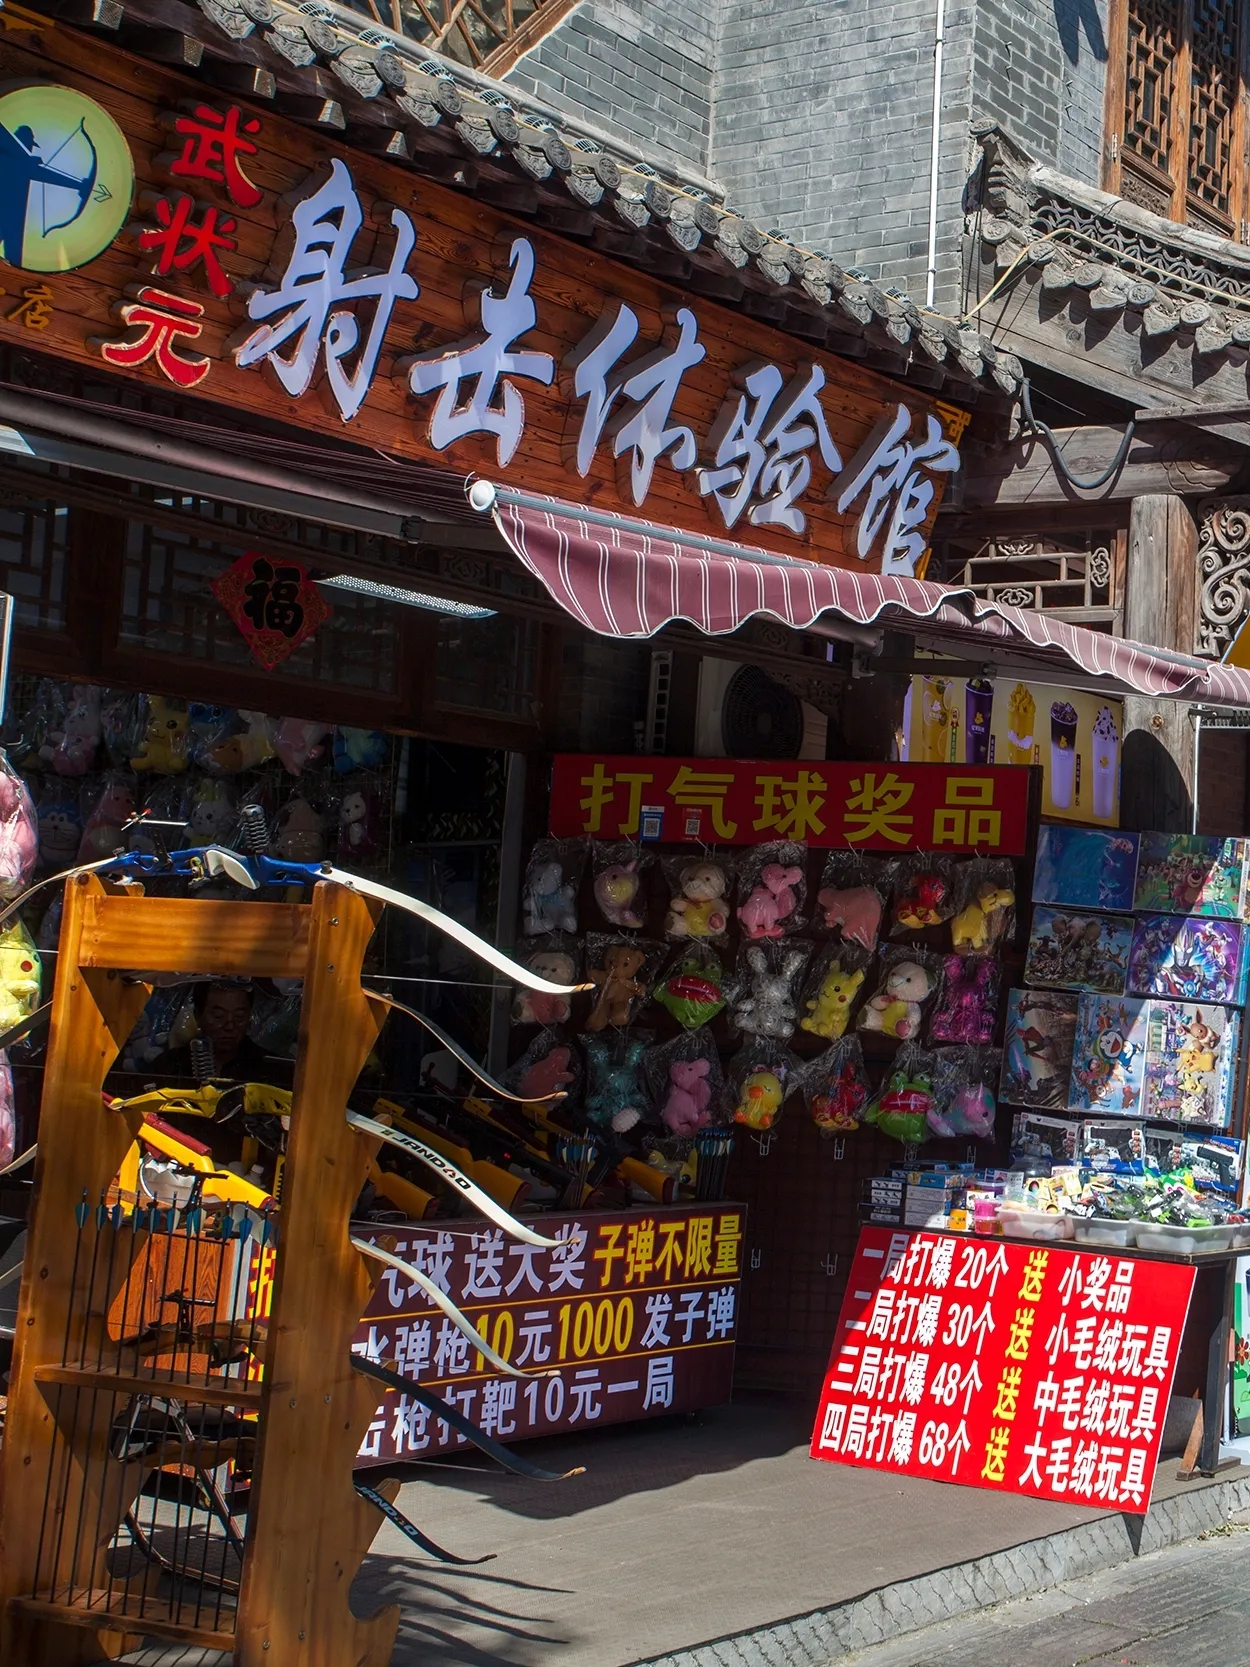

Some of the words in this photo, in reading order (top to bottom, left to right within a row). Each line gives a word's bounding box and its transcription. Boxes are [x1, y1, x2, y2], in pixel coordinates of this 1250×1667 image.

[102, 104, 264, 389] 武状元
[236, 157, 960, 577] 射击体验馆
[243, 556, 305, 638] 福
[580, 763, 1002, 847] 打气球奖品
[593, 1214, 742, 1288] 子弹不限量
[1018, 1250, 1049, 1302] 送
[1058, 1255, 1135, 1314] 小奖品
[1005, 1307, 1036, 1361] 送
[1045, 1312, 1172, 1382] 小毛绒玩具
[993, 1366, 1023, 1421] 送
[1033, 1370, 1159, 1444] 中毛绒玩具
[981, 1426, 1011, 1482] 送
[1018, 1431, 1148, 1506] 大毛绒玩具
